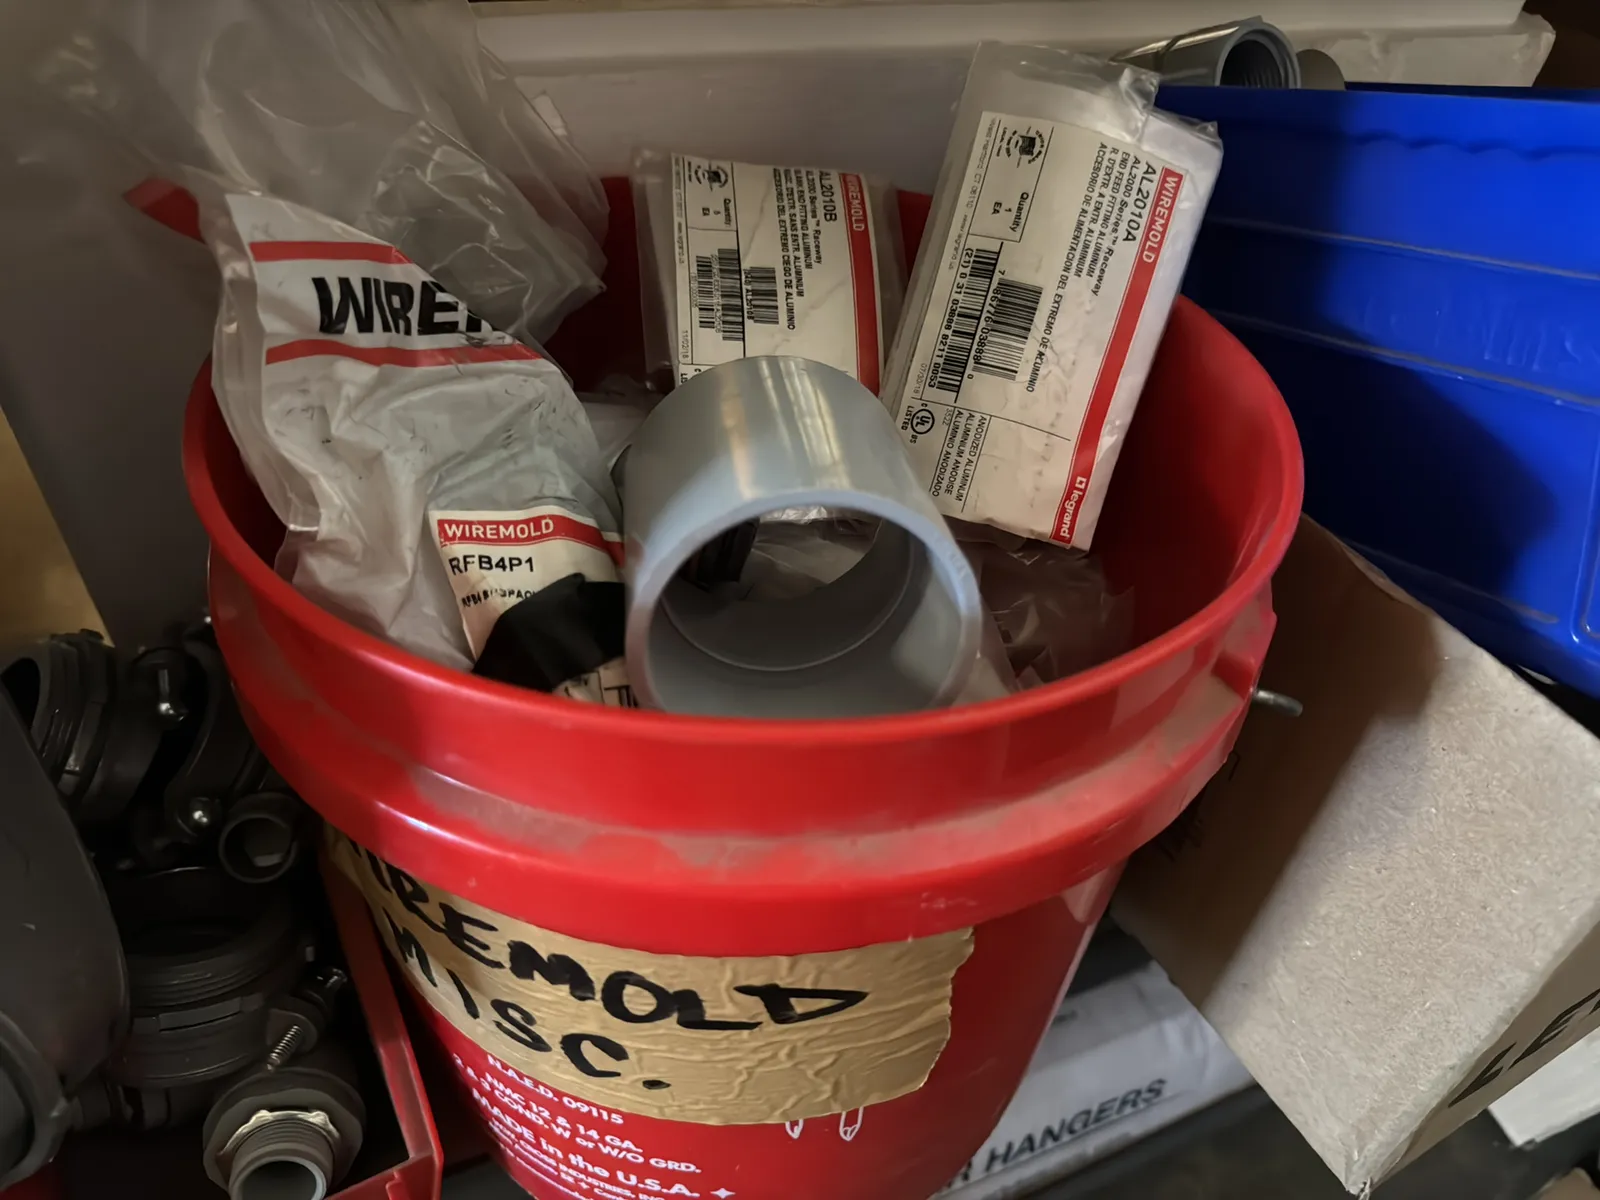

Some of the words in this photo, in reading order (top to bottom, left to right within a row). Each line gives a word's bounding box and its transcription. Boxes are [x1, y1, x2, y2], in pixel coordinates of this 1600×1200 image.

[1085, 141, 1108, 193] ACCESORIO
[1117, 151, 1130, 170] END
[1121, 155, 1141, 198] AL2000
[818, 169, 836, 222] AL2010B
[1081, 194, 1092, 207] DE
[1110, 169, 1124, 194] FEED
[776, 204, 785, 217] DEL
[788, 212, 797, 232] SANS
[798, 204, 808, 231] FITTING
[991, 200, 1002, 216] EA
[1008, 190, 1029, 233] Quantity
[1099, 195, 1117, 229] FITTING
[1122, 161, 1158, 244] AL2010A
[1140, 174, 1178, 264] WIREMOLD
[778, 219, 788, 252] EXTREMO
[801, 232, 812, 269] ALUMINUM
[811, 229, 822, 264] Raceway
[1061, 207, 1088, 273] ALIMENTACION
[1073, 227, 1095, 278] ALUMINIUM
[1085, 230, 1106, 277] ALUMINUM
[781, 254, 790, 276] CIEGO
[792, 255, 803, 296] ALUMINIUM
[960, 246, 974, 269] (21)
[1089, 245, 1114, 297] Raceway
[784, 278, 791, 288] DE
[954, 281, 964, 295] 31
[1055, 273, 1068, 291] DEL
[312, 277, 484, 335] WIRE
[784, 291, 795, 329] ALUMINIO
[983, 287, 1001, 324] 86776
[1042, 293, 1062, 335] EXTREMO
[935, 333, 949, 359] 8211
[972, 326, 990, 362] 03888
[1038, 336, 1049, 349] DE
[927, 361, 941, 388] 0053
[1024, 349, 1045, 393] ALUMINIO
[900, 405, 914, 431] LISTED
[945, 409, 963, 449] ALUMINIO
[955, 412, 974, 458] ALUMINIUM
[968, 415, 987, 457] ANODIZED
[931, 449, 951, 497] ANODIZADO
[944, 458, 961, 495] ANODISE
[954, 457, 974, 501] ALUMINUM
[444, 519, 554, 539] WIREMOLD
[1055, 488, 1083, 537] legrand
[449, 555, 534, 576] RFB4P1
[382, 906, 671, 1090] MISC.
[488, 1053, 558, 1101] N.A.E.D.
[563, 1096, 623, 1124] 09115
[484, 1072, 524, 1105] NMC
[529, 1101, 550, 1119] 12
[550, 1115, 570, 1128] &
[576, 1123, 600, 1140] 14
[604, 1135, 643, 1152] GA.
[494, 1090, 549, 1128] COND.
[552, 1123, 571, 1139] W
[575, 1137, 595, 1148] or
[597, 1142, 644, 1163] W/O
[649, 1158, 701, 1173] GRD.
[985, 1078, 1167, 1172] HANGERS
[472, 1088, 534, 1142] MADE
[540, 1138, 563, 1158] in
[568, 1152, 609, 1178] the
[616, 1170, 700, 1197] U.S.A.
